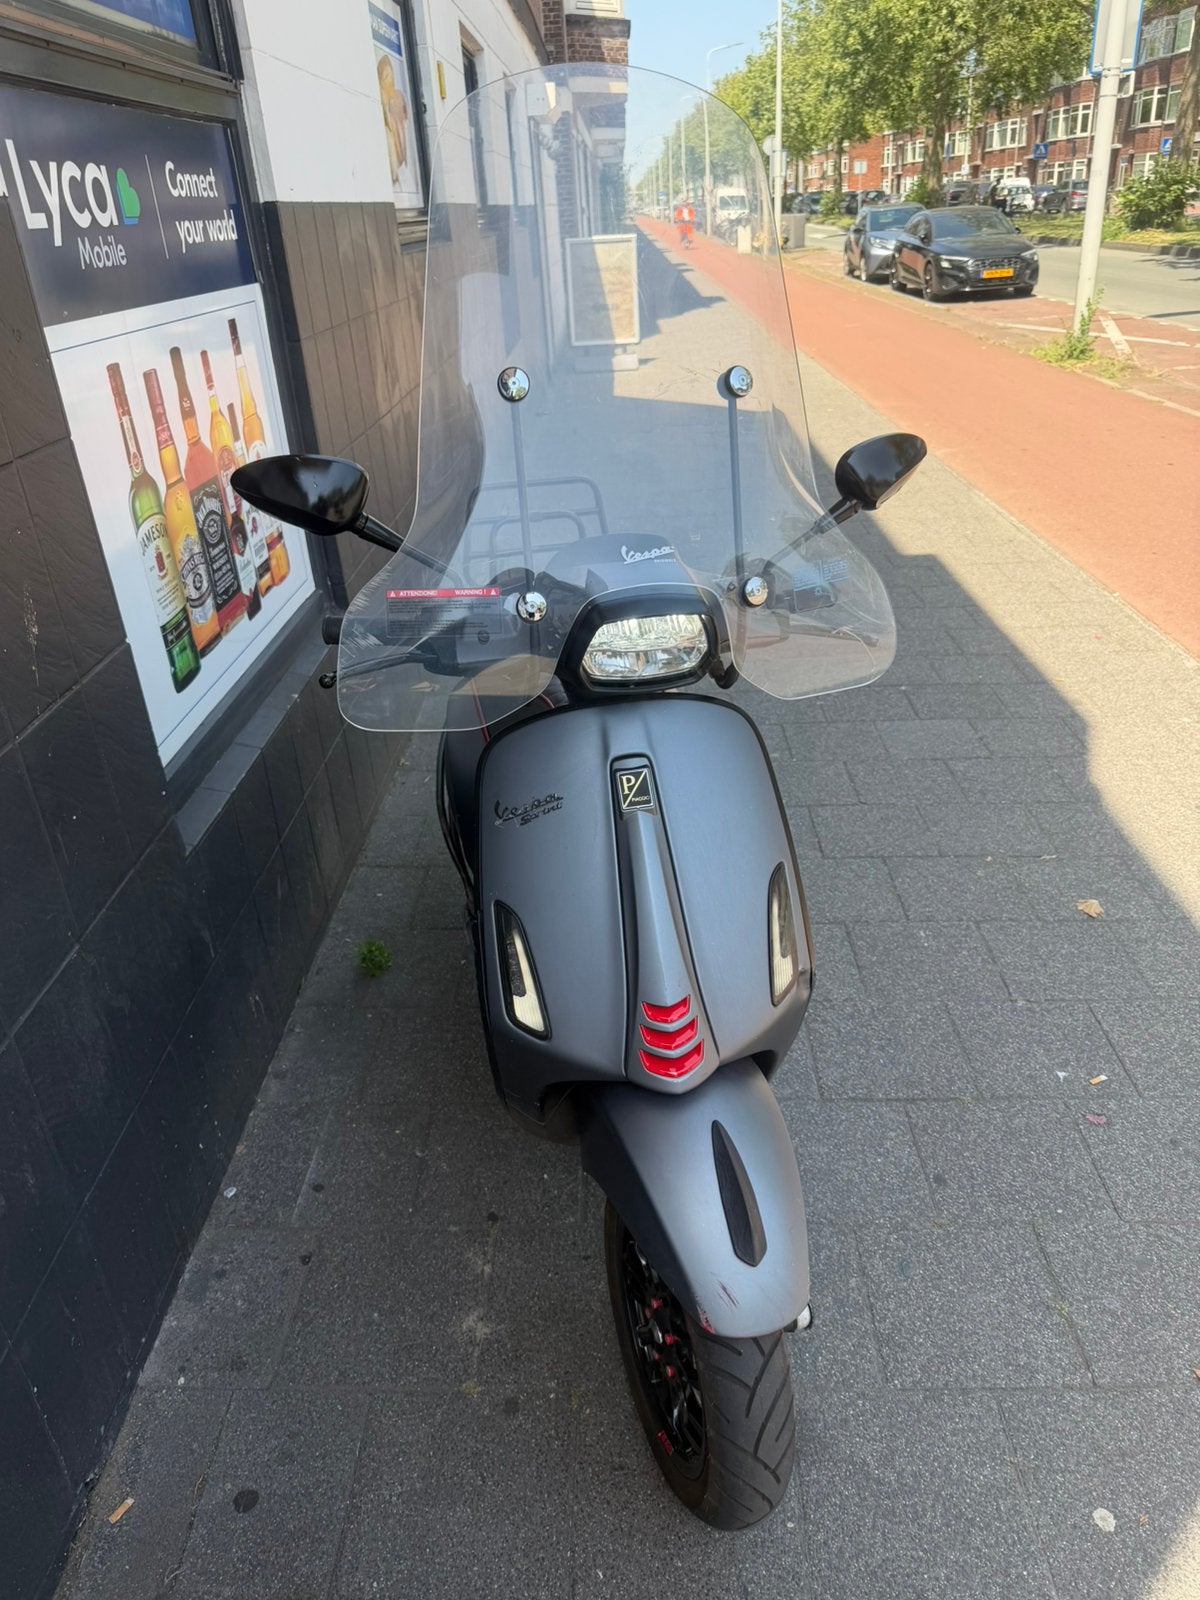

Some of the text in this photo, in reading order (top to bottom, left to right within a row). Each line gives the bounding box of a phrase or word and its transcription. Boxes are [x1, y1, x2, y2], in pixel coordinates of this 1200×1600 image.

[5, 138, 119, 247] Lyca
[165, 161, 219, 198] Connect
[175, 210, 238, 254] your world
[78, 235, 128, 270] Mobile
[621, 545, 676, 565] Vespa
[455, 588, 483, 596] WARNING
[621, 775, 636, 795] P
[494, 793, 564, 822] Vespa
